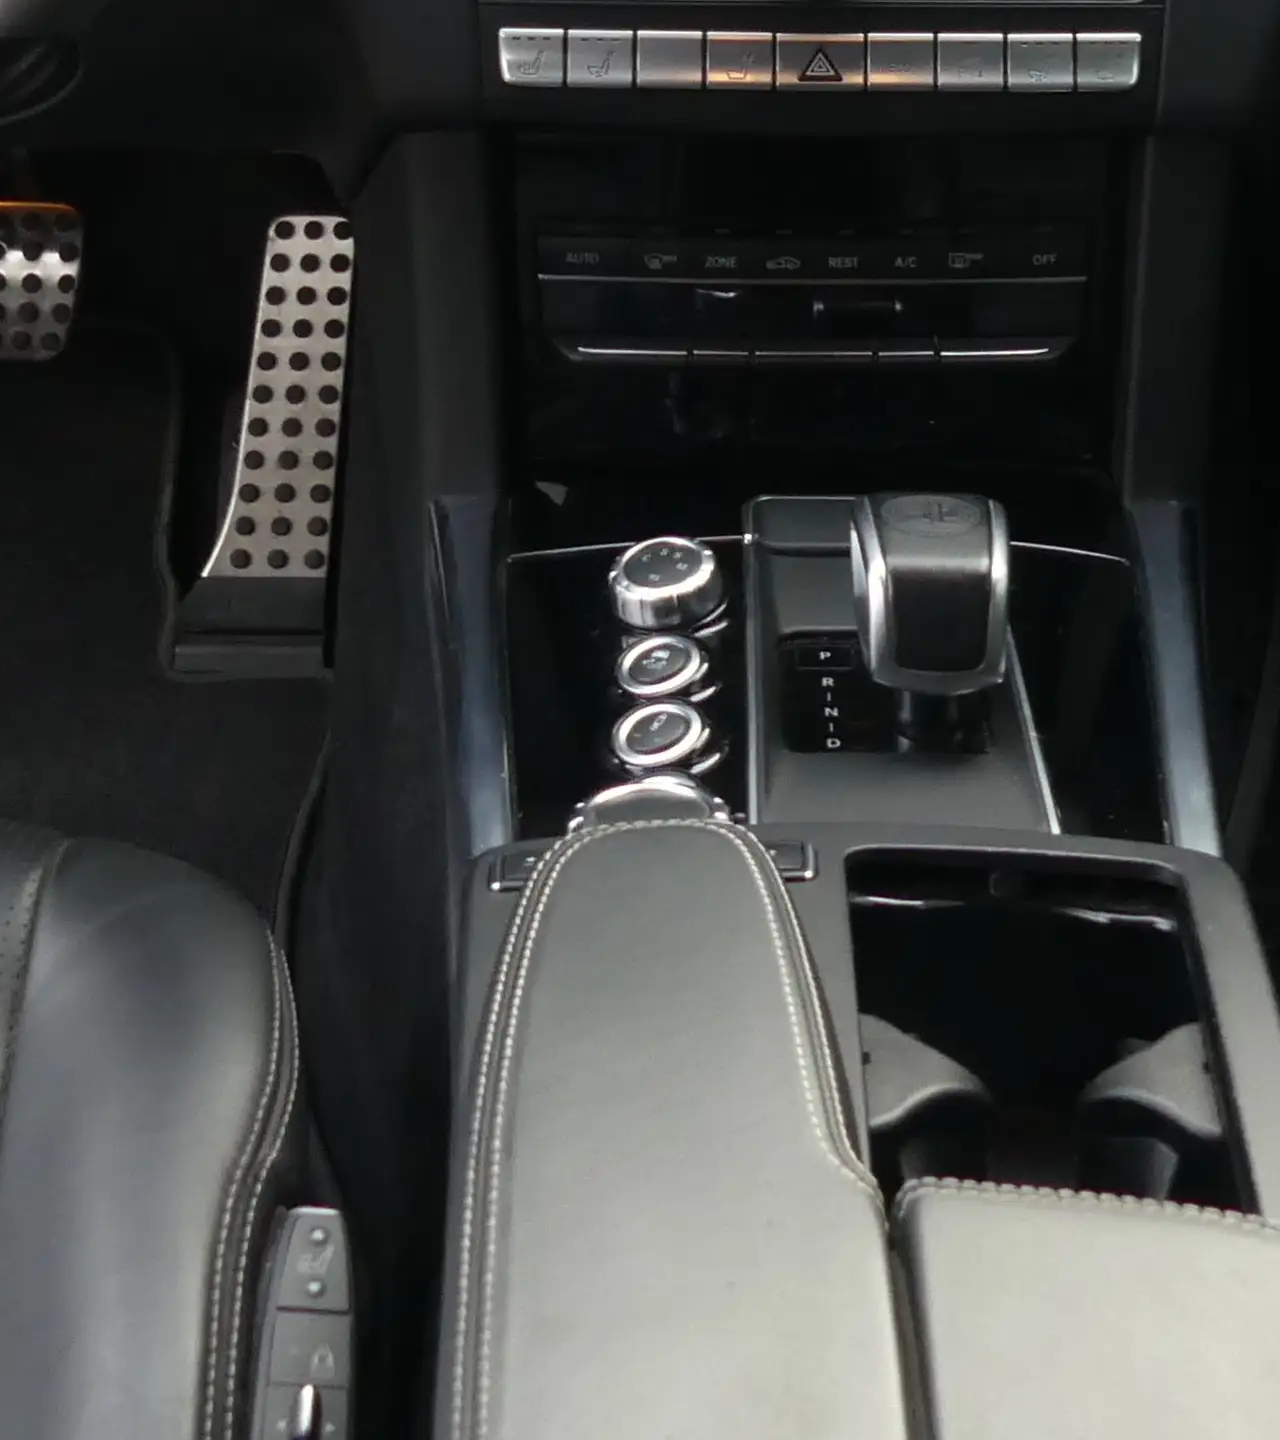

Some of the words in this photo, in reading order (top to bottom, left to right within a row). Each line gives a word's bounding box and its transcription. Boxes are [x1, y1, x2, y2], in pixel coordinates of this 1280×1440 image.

[565, 253, 599, 264] AUTO
[705, 256, 737, 269] ZONE
[828, 256, 858, 269] REST
[895, 256, 916, 268] A/C
[1032, 254, 1056, 266] OFF
[819, 651, 831, 660] P
[822, 677, 834, 687] R
[825, 706, 839, 717] N
[826, 737, 841, 748] D
